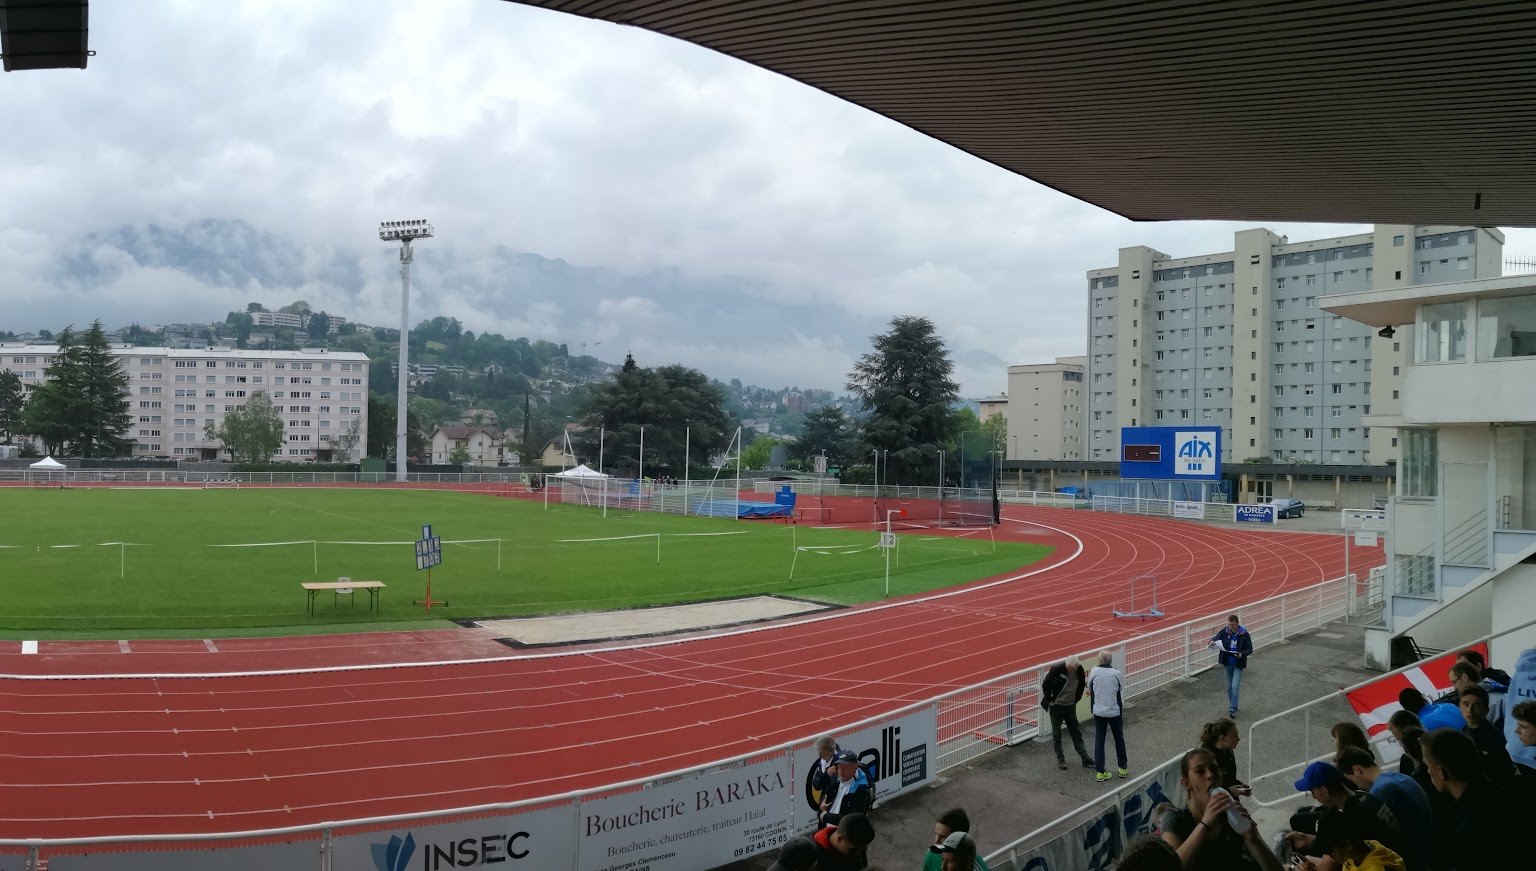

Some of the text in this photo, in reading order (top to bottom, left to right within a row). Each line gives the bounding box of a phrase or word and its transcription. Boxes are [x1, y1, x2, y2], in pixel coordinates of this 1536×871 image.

[1238, 506, 1272, 514] ADREA
[585, 771, 785, 838] Boucherie BARAKA
[712, 817, 742, 831] traiteur
[773, 819, 787, 829] Lyon
[734, 834, 788, 857] 09 82 44 75 05
[638, 852, 676, 866] Clemenceau
